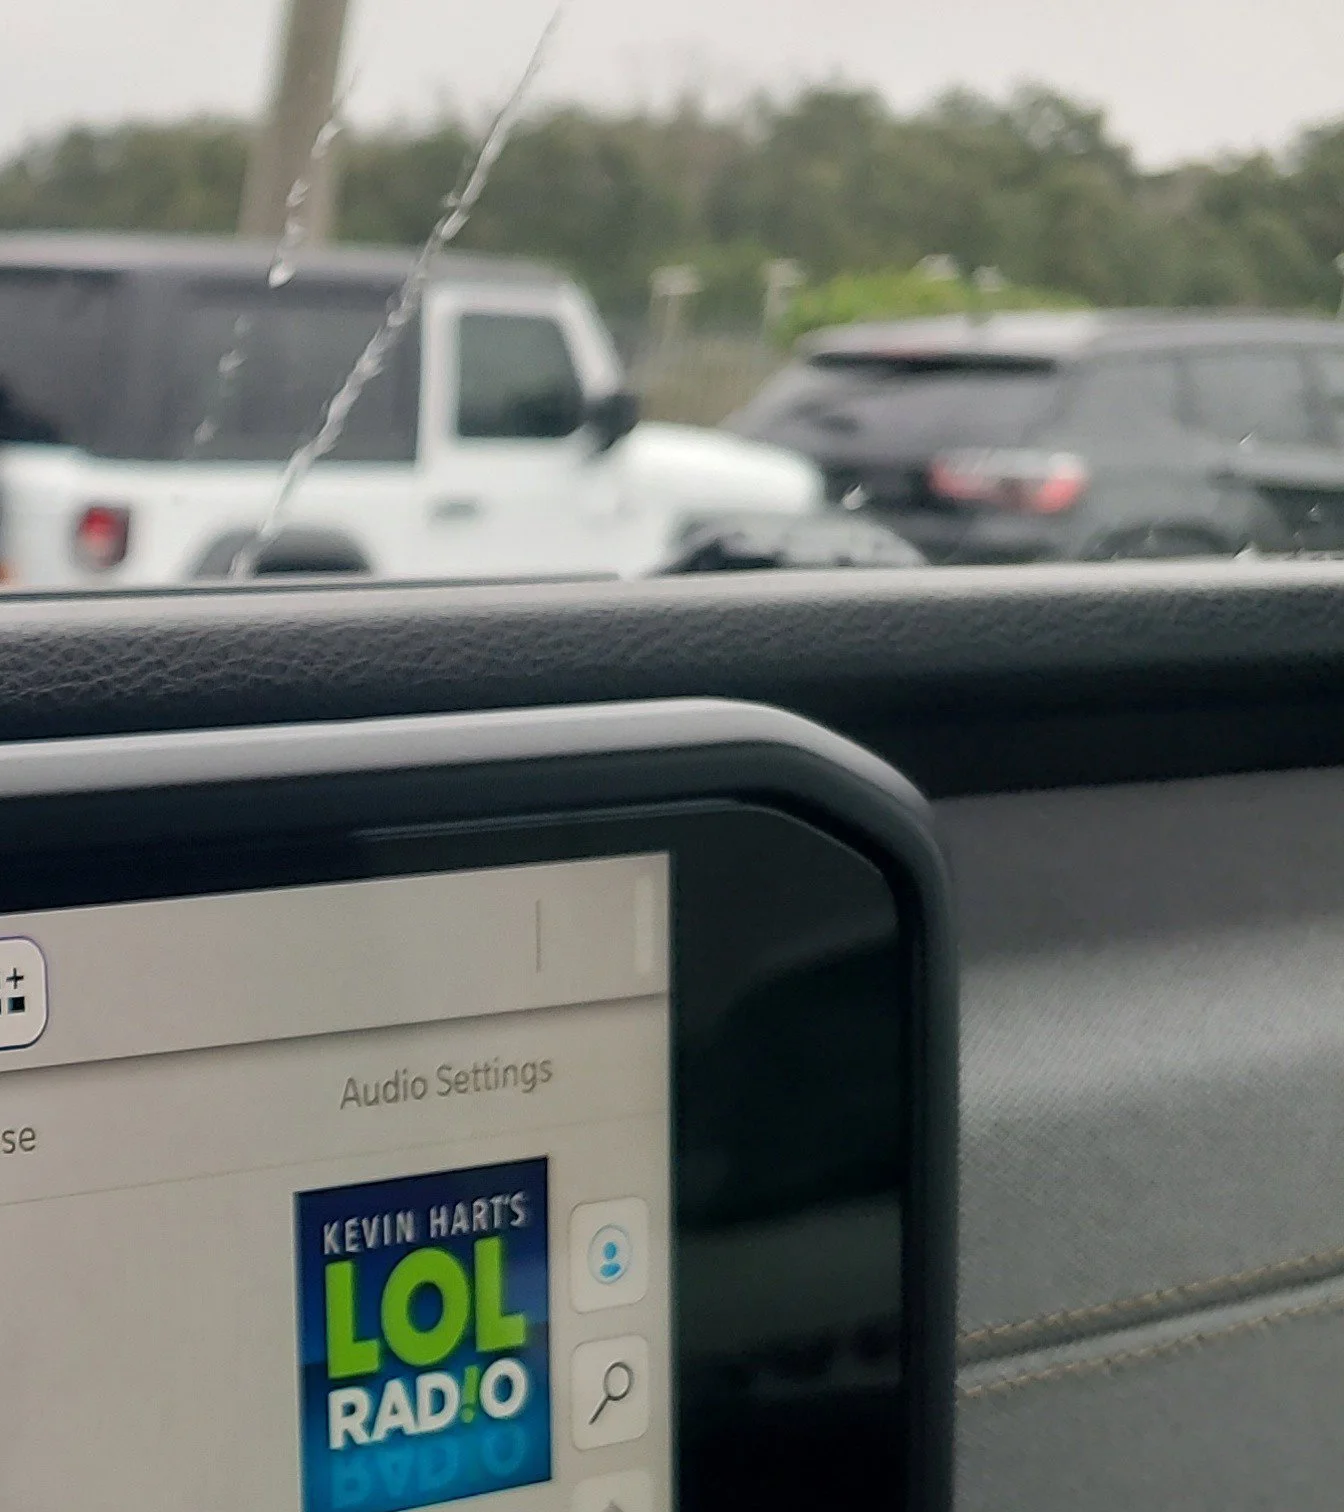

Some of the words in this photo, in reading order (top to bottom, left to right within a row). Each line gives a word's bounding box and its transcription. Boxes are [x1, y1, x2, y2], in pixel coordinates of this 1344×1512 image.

[340, 1069, 428, 1110] Audio
[436, 1056, 553, 1097] Settings
[324, 1210, 415, 1255] KEVIN
[430, 1192, 529, 1240] HART'S
[325, 1236, 527, 1379] LOL
